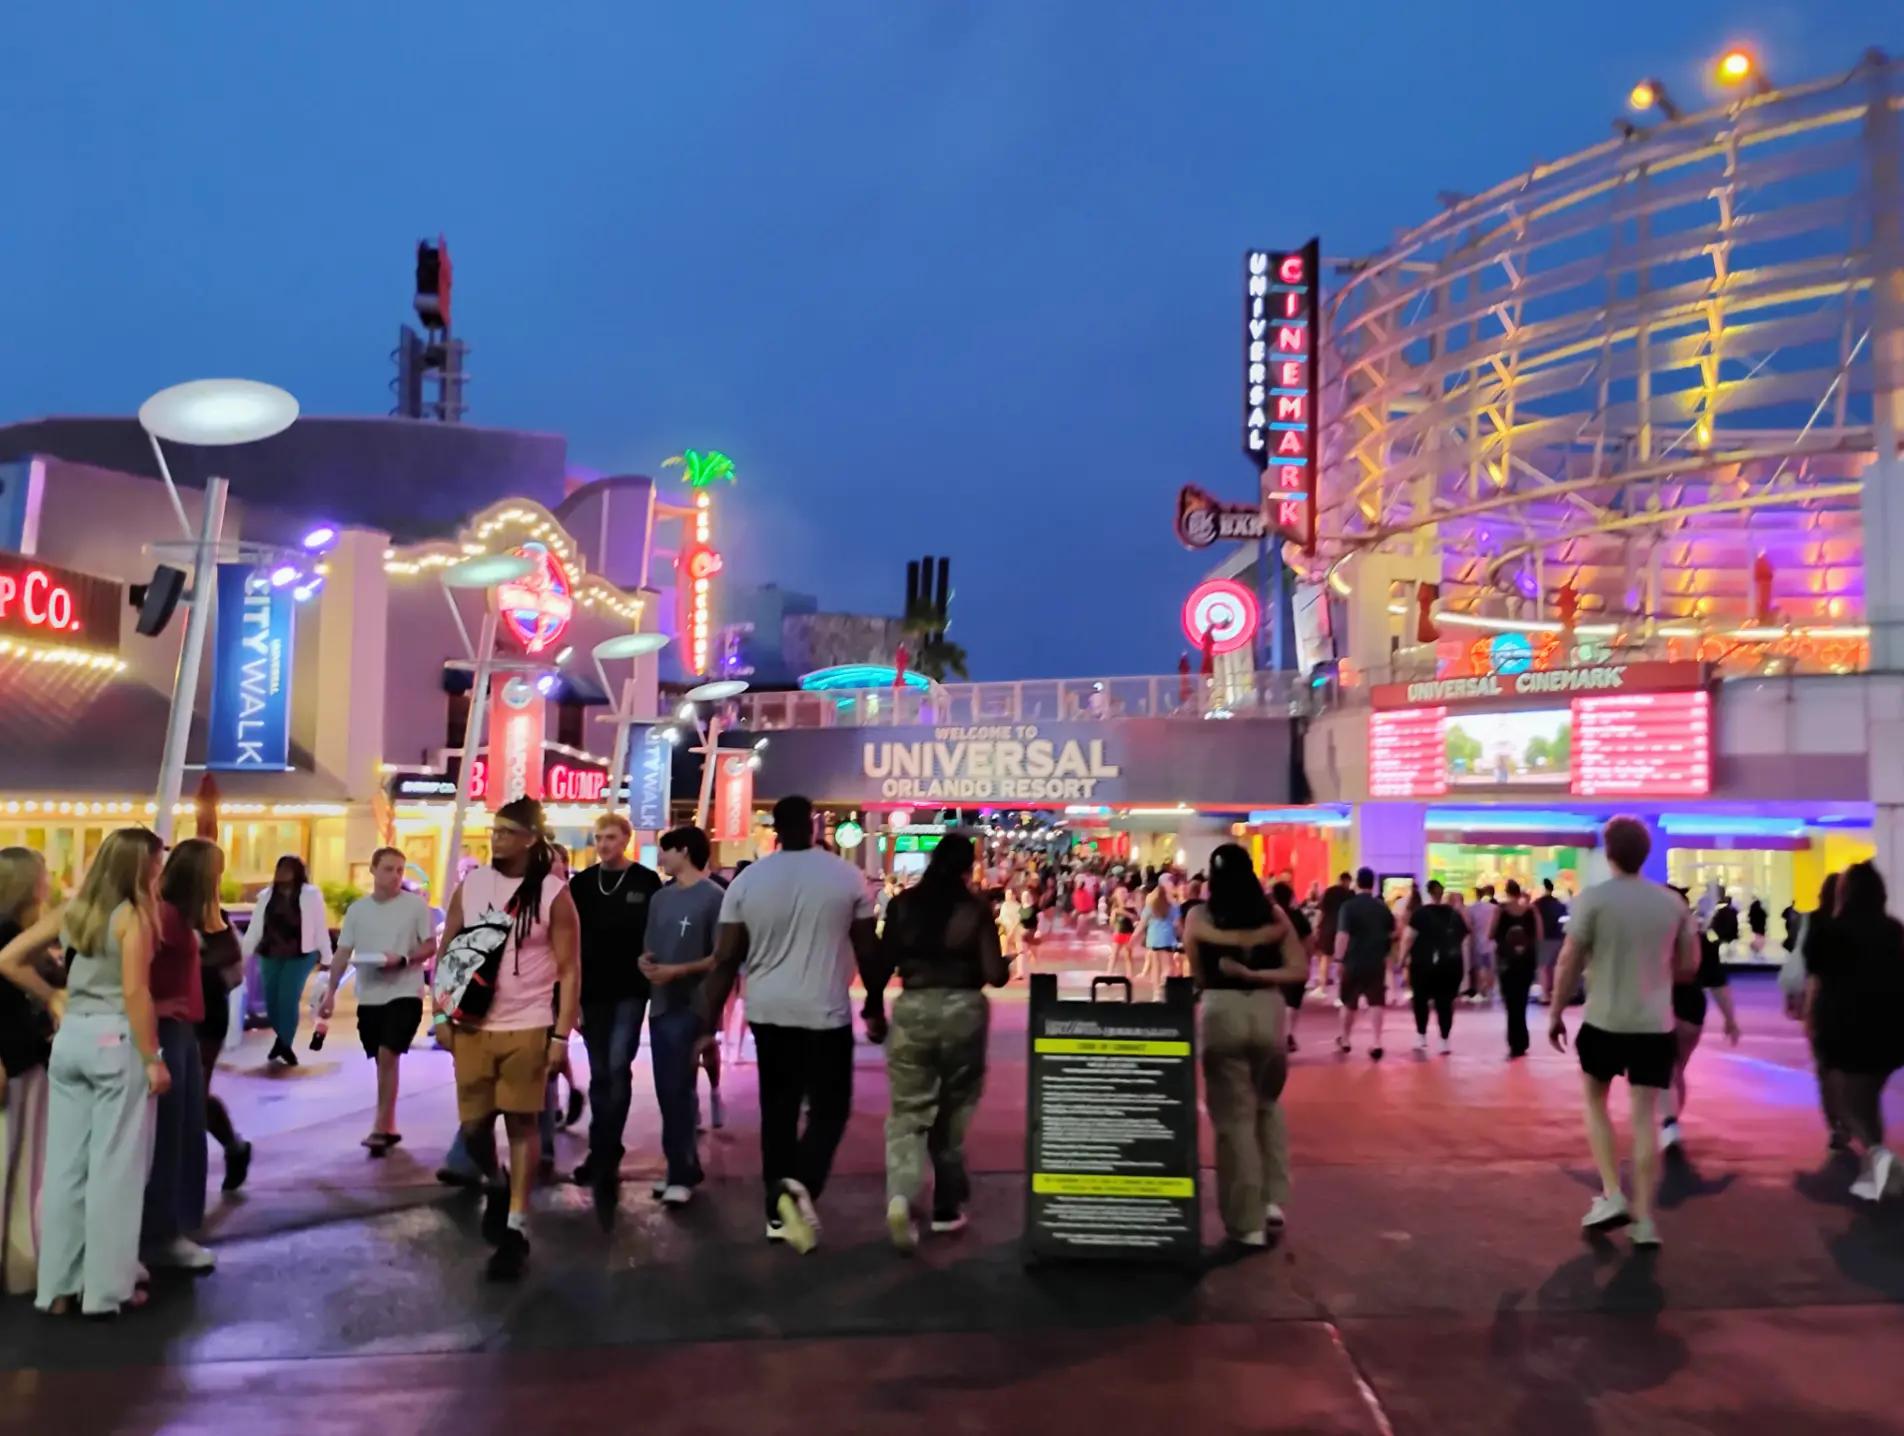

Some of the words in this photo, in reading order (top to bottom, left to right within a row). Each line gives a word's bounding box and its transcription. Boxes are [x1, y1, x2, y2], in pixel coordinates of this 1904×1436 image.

[1248, 252, 1268, 450] UNIVERSAL
[1278, 255, 1304, 526] CINEMARK
[1407, 675, 1503, 703] UNIVERSAL
[1514, 666, 1628, 694] CINEMARK
[934, 725, 1011, 740] WELCOME
[1015, 725, 1038, 740] TO
[862, 739, 1119, 779] UNIVERSAL
[881, 778, 992, 798] ORLANDO
[1001, 778, 1098, 799] RESORT
